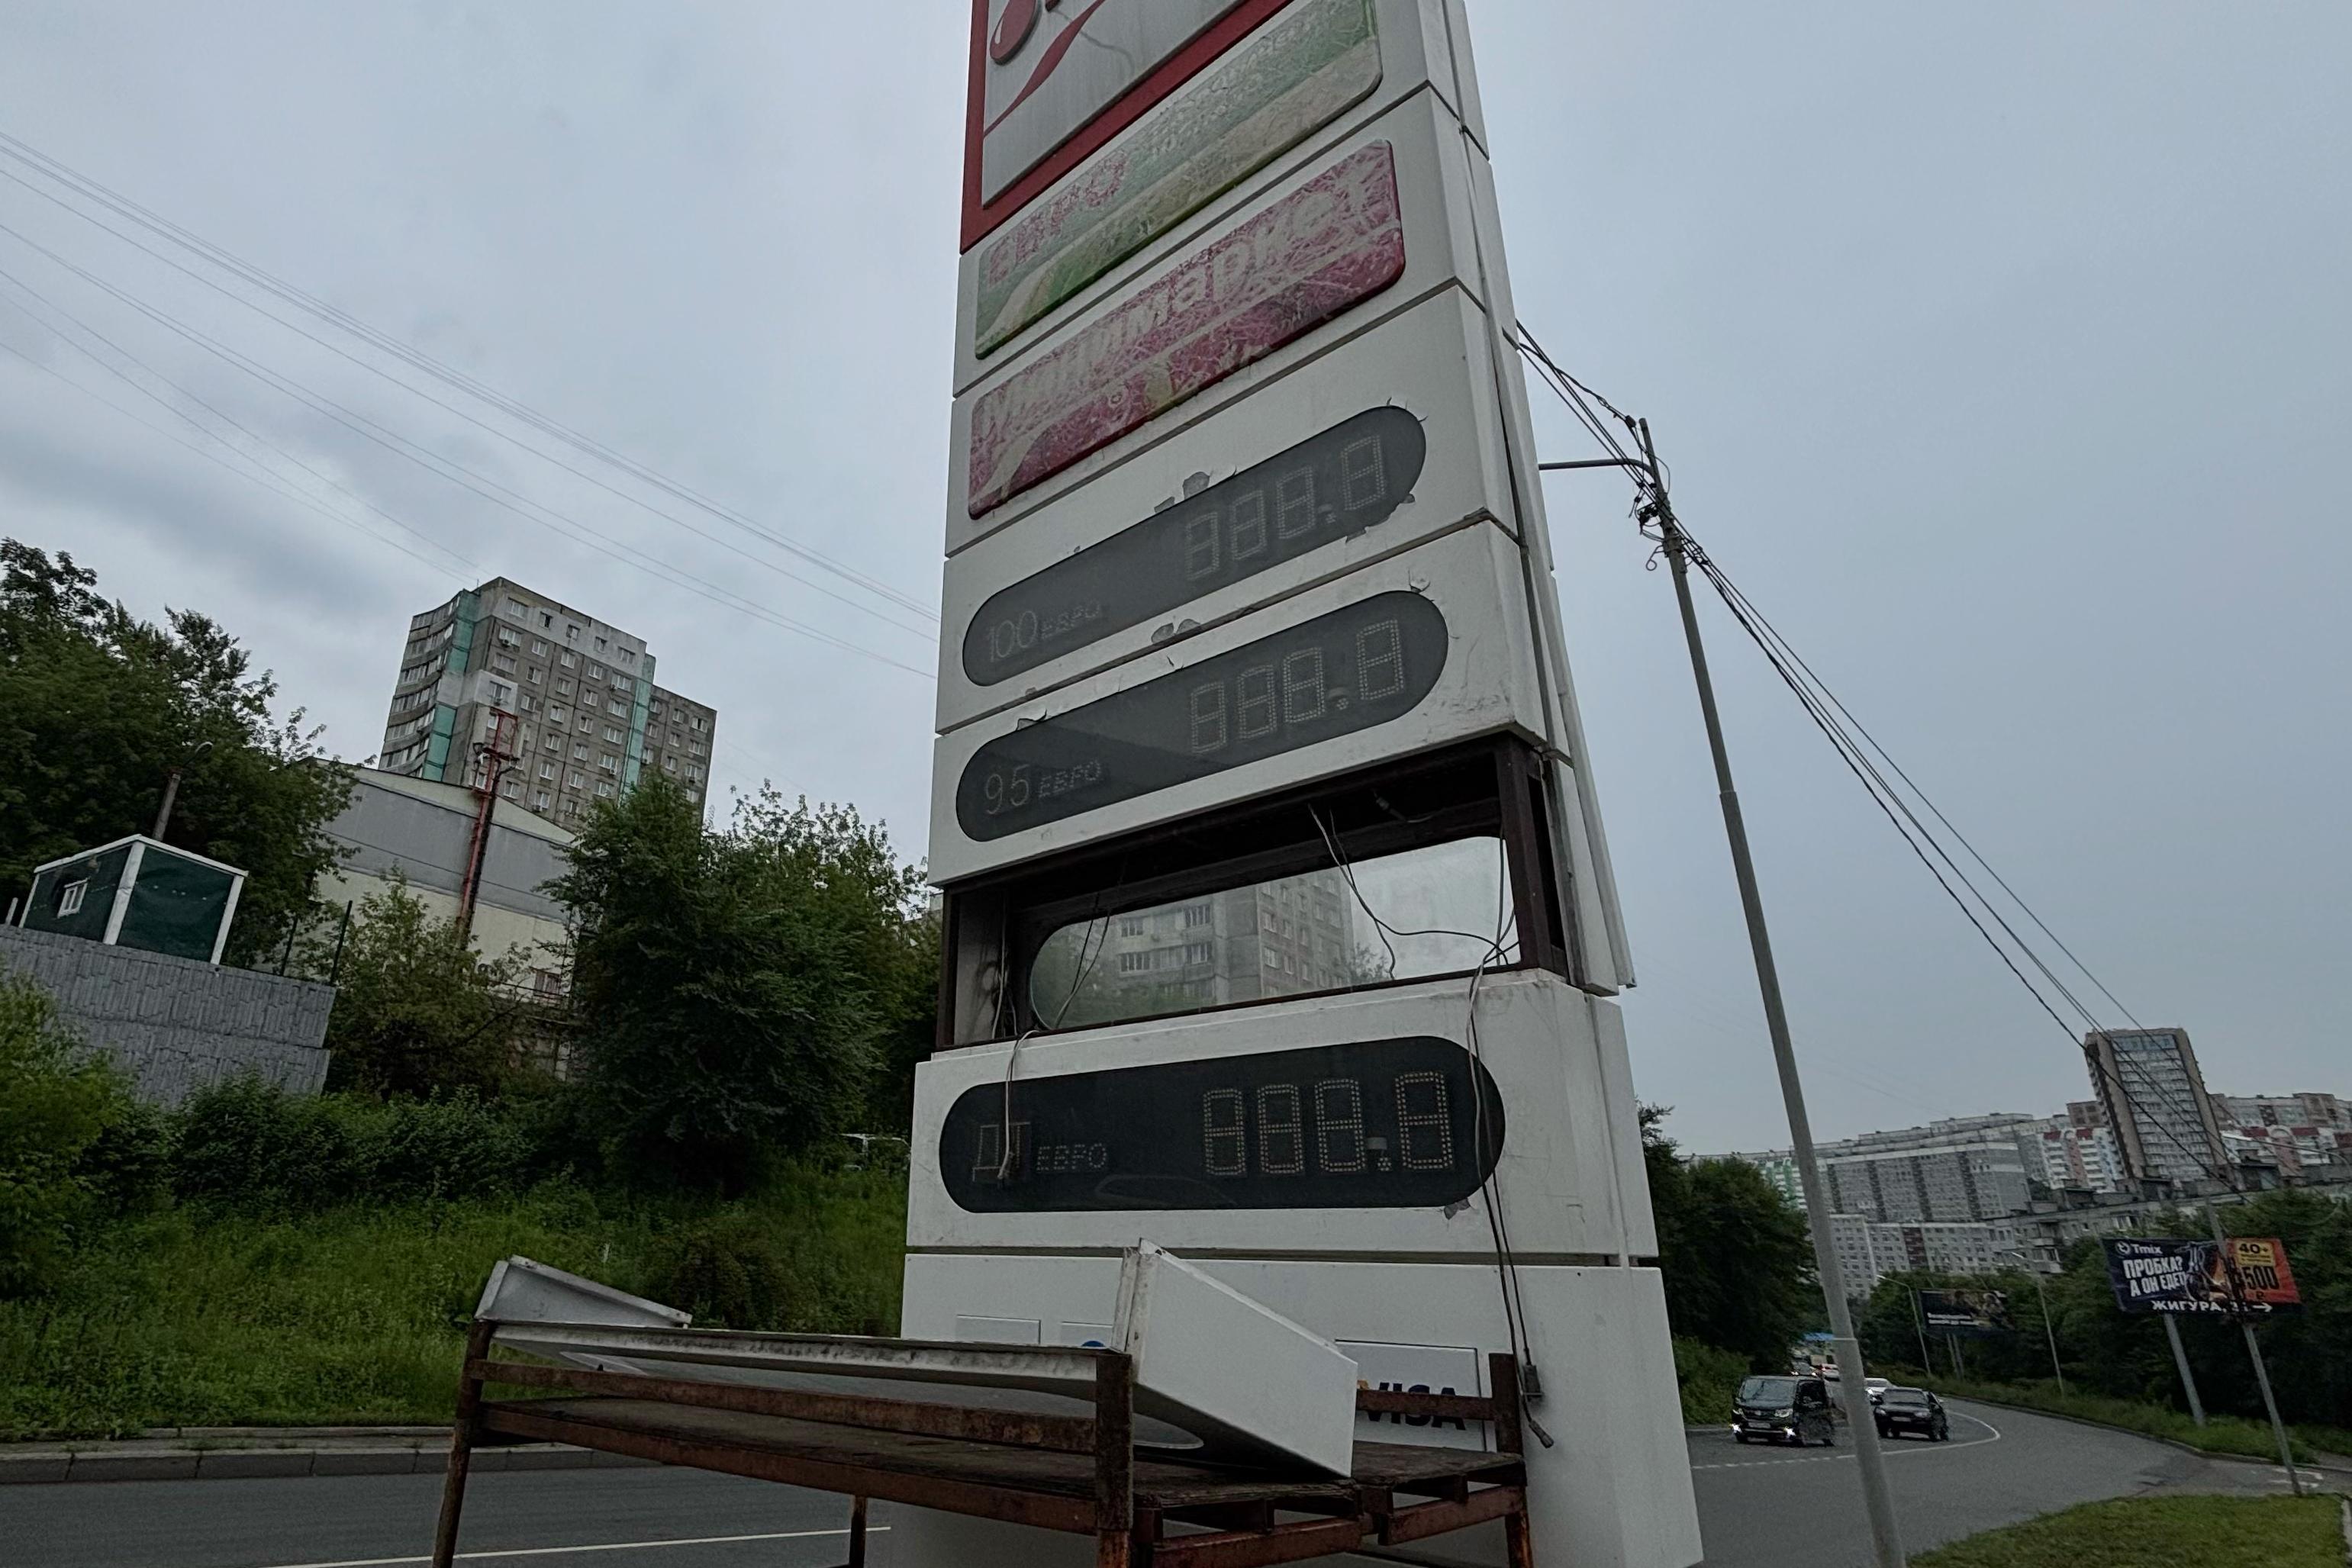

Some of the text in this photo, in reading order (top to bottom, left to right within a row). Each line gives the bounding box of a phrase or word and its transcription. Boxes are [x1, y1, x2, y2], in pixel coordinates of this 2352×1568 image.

[989, 610, 1039, 665] 100
[984, 764, 1030, 815] 95
[1036, 1142, 1107, 1173] ЕВРО
[2131, 1244, 2164, 1254] Tmix
[2238, 1243, 2269, 1254] 40+
[2122, 1255, 2183, 1279] ПРОБКА?
[2130, 1279, 2141, 1297] А
[2141, 1276, 2160, 1294] ОН
